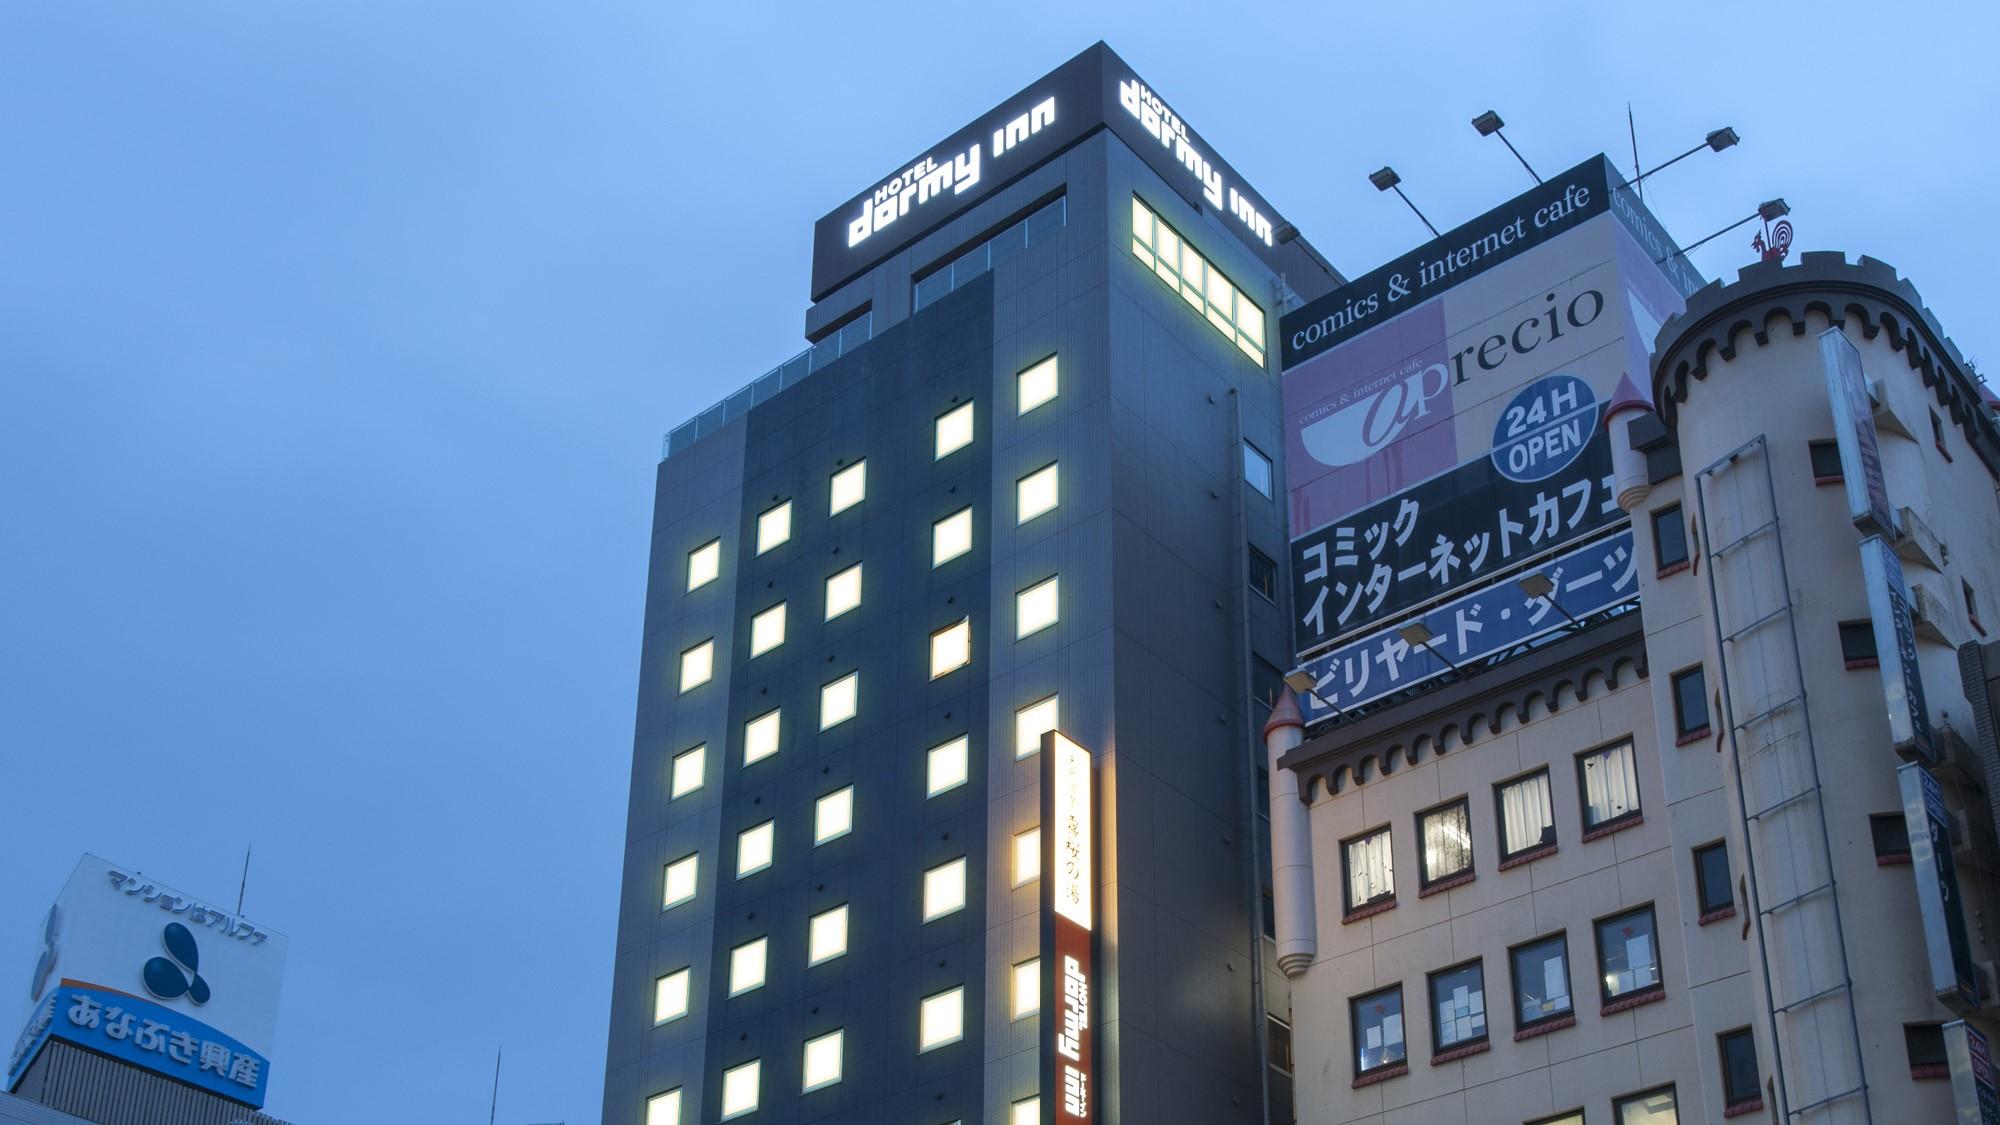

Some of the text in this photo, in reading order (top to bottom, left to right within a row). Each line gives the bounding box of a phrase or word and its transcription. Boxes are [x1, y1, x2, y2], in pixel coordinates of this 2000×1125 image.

[1141, 84, 1190, 143] HOTEL
[848, 96, 1055, 248] dormy inn
[875, 157, 938, 205] HOTEL
[1120, 79, 1272, 247] dormy inn
[1291, 184, 1591, 351] comics & internet cafe
[1612, 187, 1663, 259] comics
[1681, 265, 1700, 296] in
[1299, 358, 1423, 425] comics & internet cafe
[1505, 380, 1579, 438] 24H
[1508, 417, 1582, 475] OPEN
[1303, 498, 1420, 584] コミック
[108, 870, 268, 946] マンションはアルファ
[67, 993, 261, 1090] あなぶき興産
[1058, 955, 1086, 1118] dormy inn
